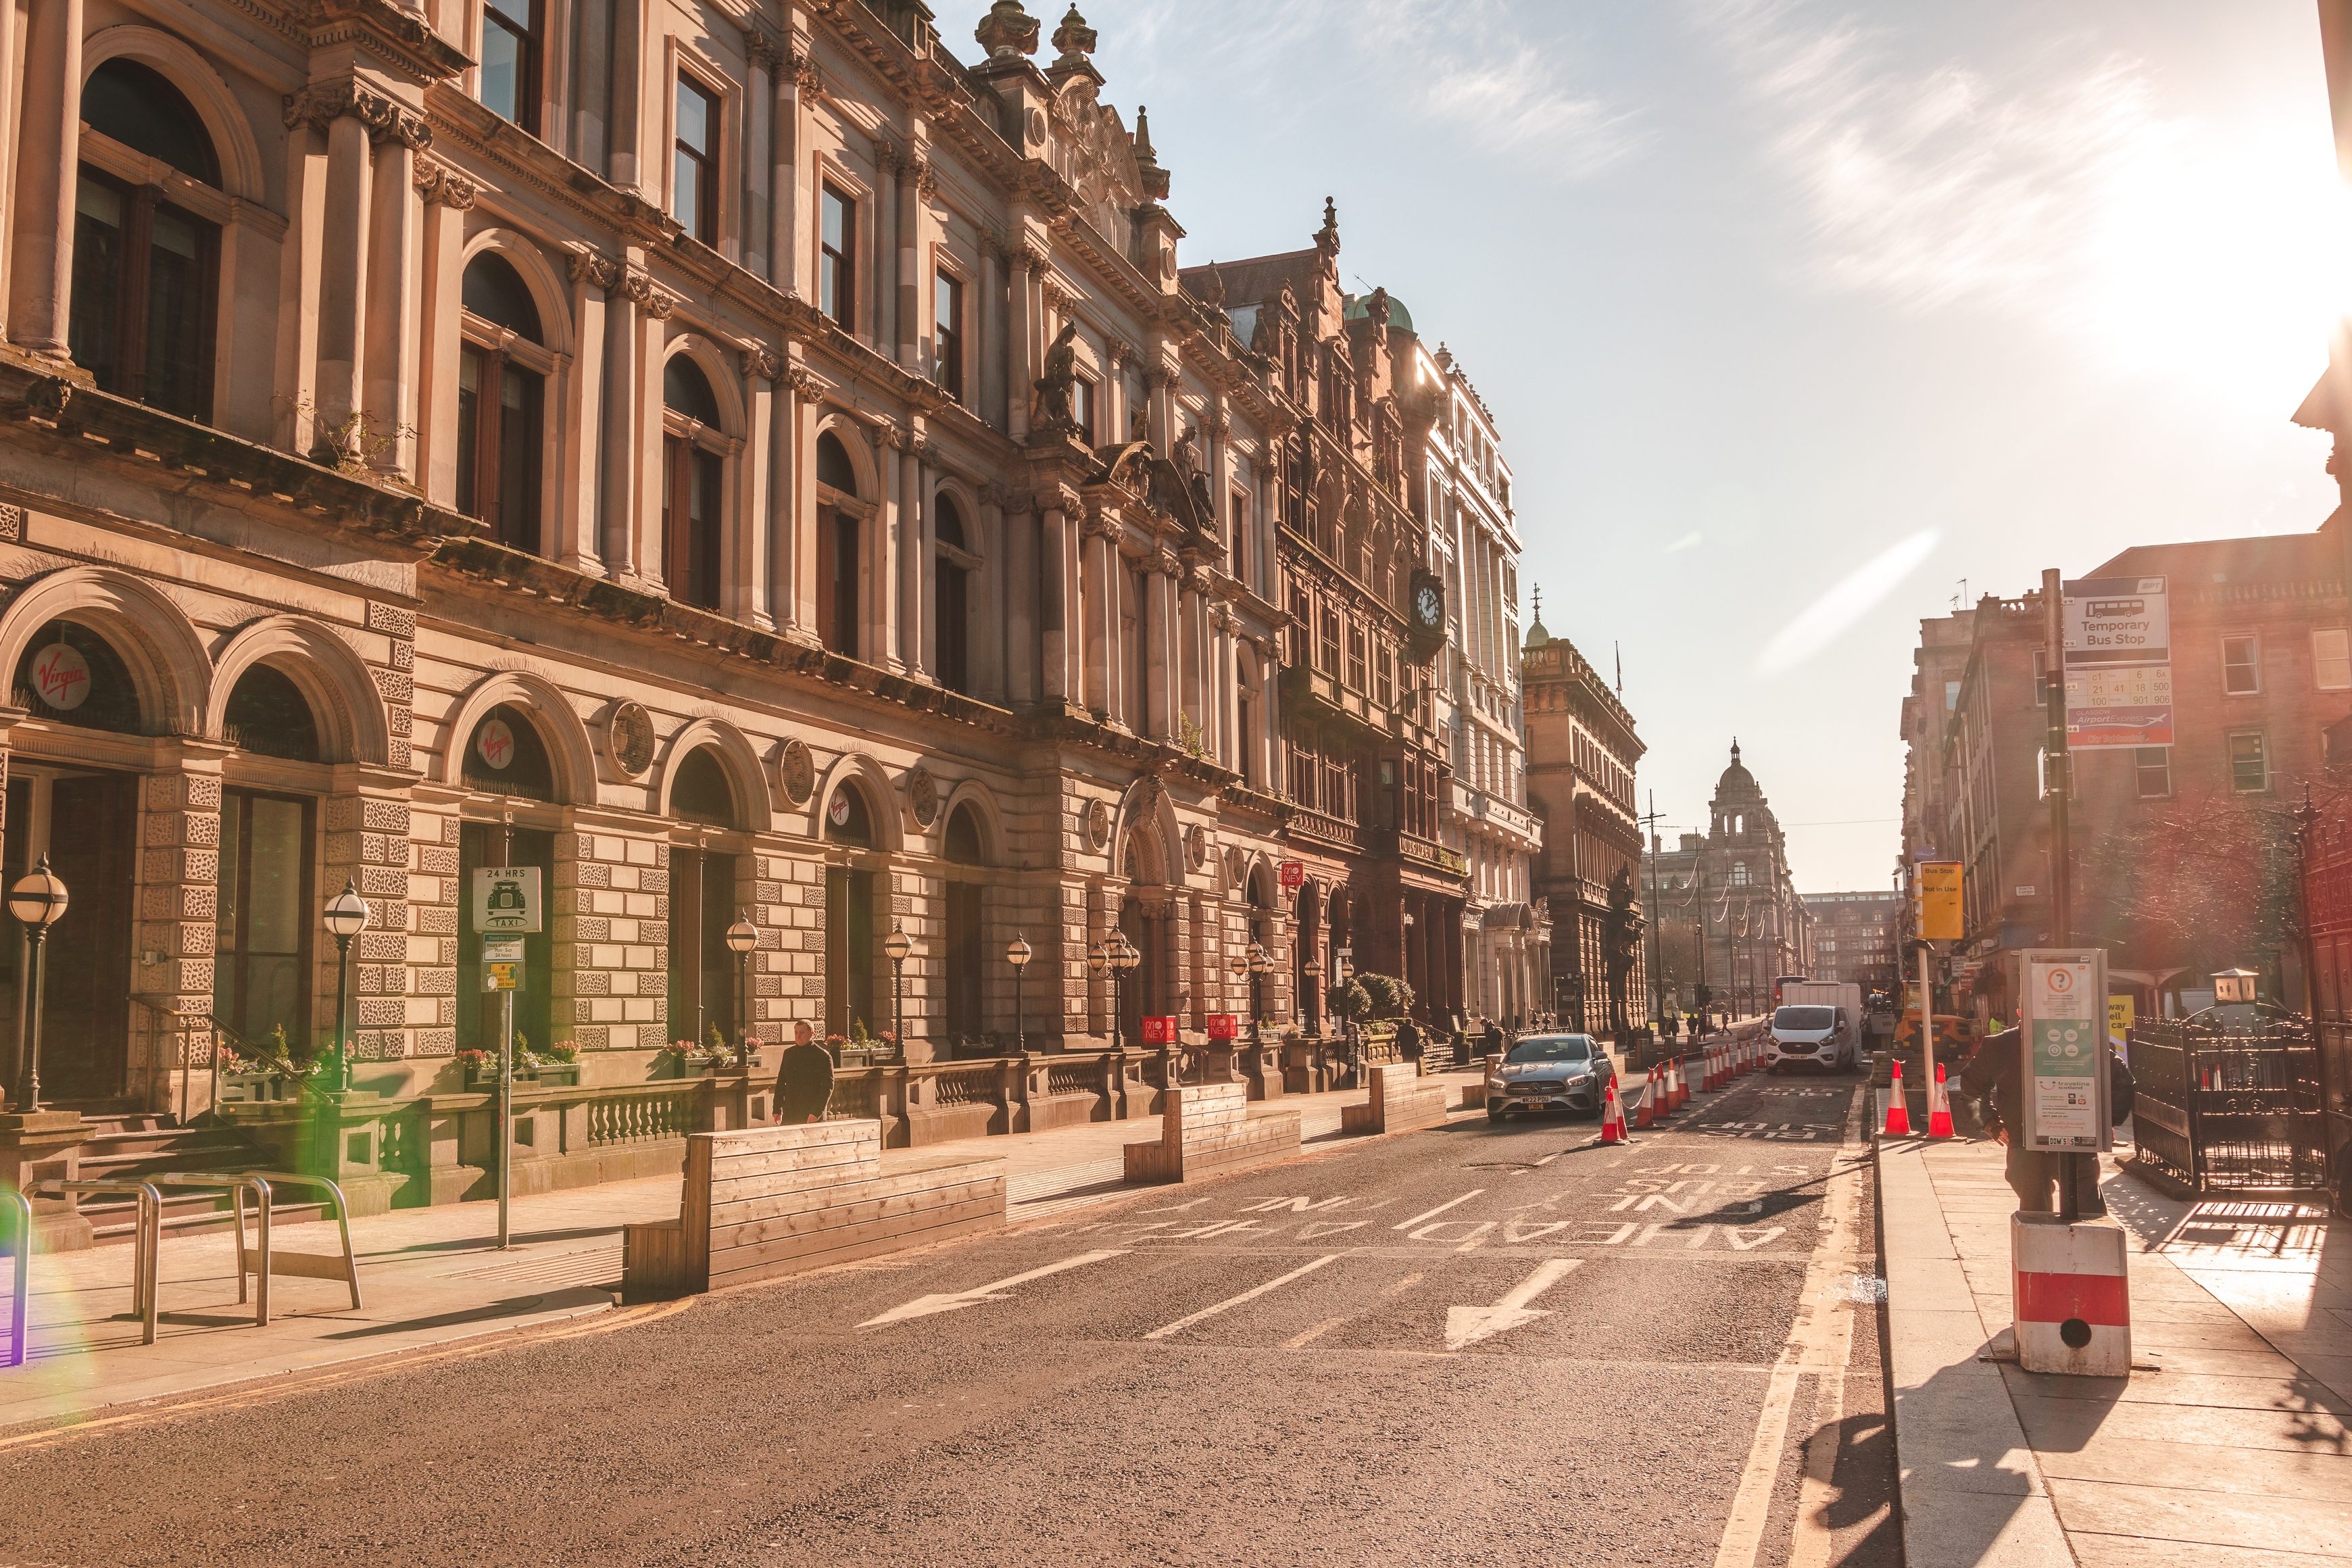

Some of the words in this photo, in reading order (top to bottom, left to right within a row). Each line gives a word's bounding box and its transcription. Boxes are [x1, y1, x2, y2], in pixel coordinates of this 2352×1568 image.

[2081, 621, 2150, 633] Temporary
[2087, 635, 2111, 645] Bus
[2115, 634, 2146, 645] Stop
[39, 652, 87, 701] Virgin
[2136, 670, 2142, 679] 6
[2156, 670, 2166, 678] 6A
[2092, 685, 2103, 694] 21
[2114, 685, 2124, 693] 41
[2136, 683, 2145, 691] 18
[2153, 683, 2169, 691] 500
[2091, 697, 2107, 706] 100
[2133, 696, 2148, 704] 901
[2154, 695, 2170, 704] 906
[484, 725, 511, 762] Virgin
[831, 793, 848, 820] Virgin
[487, 870, 500, 878] 24
[506, 869, 525, 877] HRS
[1697, 1122, 1838, 1131] STOP
[1698, 1130, 1816, 1140] BUS
[1633, 1163, 1809, 1175] STOP
[1614, 1179, 1767, 1194] BUS
[1407, 1221, 1788, 1250] AHEAD
